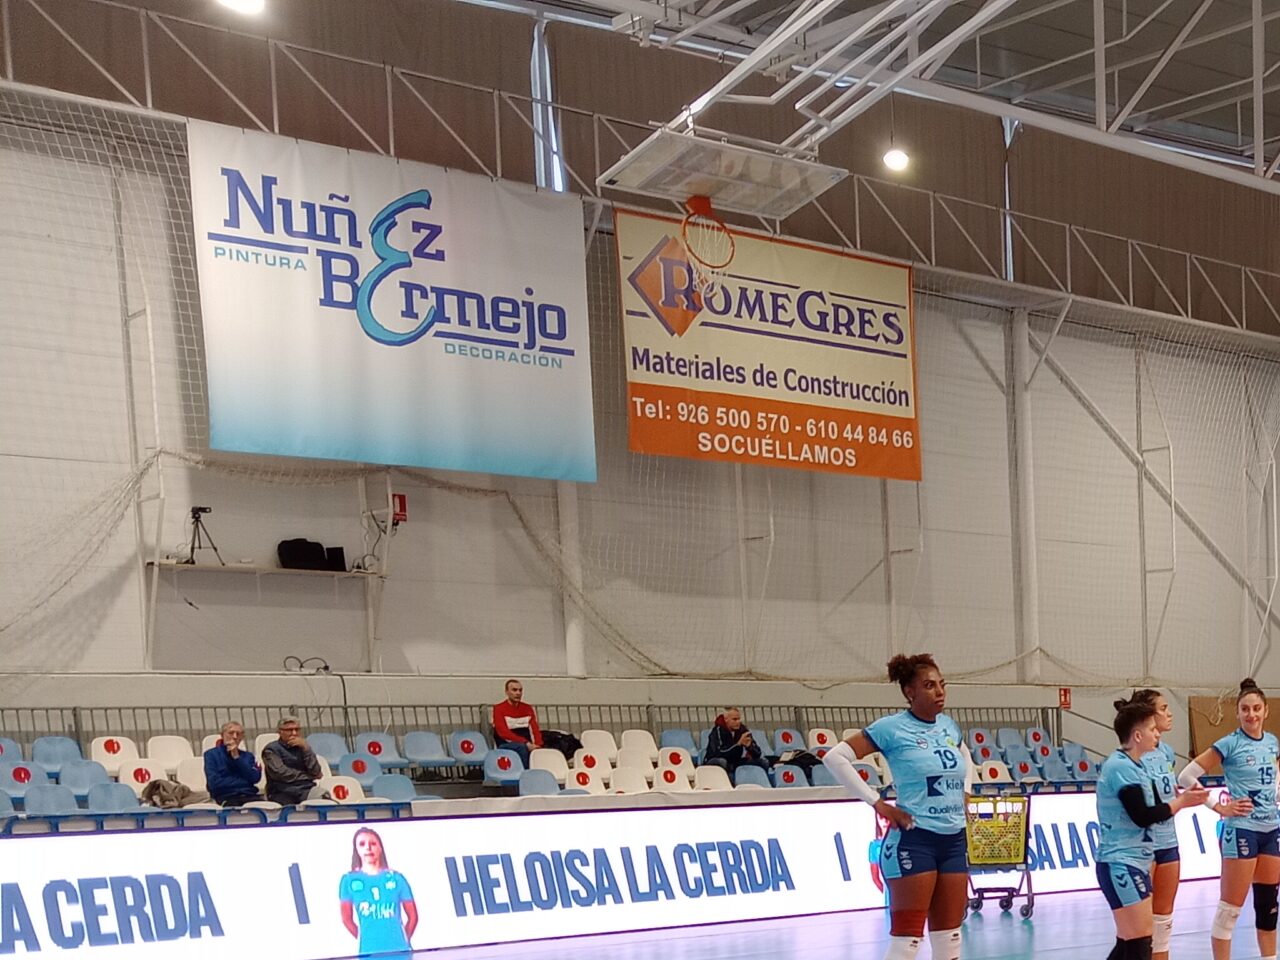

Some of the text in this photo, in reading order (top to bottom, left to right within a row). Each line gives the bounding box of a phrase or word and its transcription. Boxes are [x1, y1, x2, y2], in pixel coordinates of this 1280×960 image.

[213, 246, 308, 272] PINTURA
[443, 342, 564, 369] DECORACIÓN
[631, 346, 910, 408] Materiales de Construcción
[632, 397, 672, 421] Tel:
[677, 402, 709, 425] 926
[716, 407, 751, 430] 500
[757, 412, 790, 434] 570
[806, 419, 839, 441] 610
[843, 423, 864, 443] 44
[867, 426, 889, 446] 84
[892, 429, 914, 449] 66
[697, 432, 858, 468] SOCUÉLLAMOS
[933, 749, 958, 770] 19
[1258, 766, 1274, 785] 15
[1161, 775, 1172, 795] 8
[1051, 822, 1089, 869] LA
[444, 848, 624, 918] HELOISA
[620, 845, 675, 904] LA
[673, 837, 796, 899] CERDA
[0, 870, 225, 954] A CERDA
